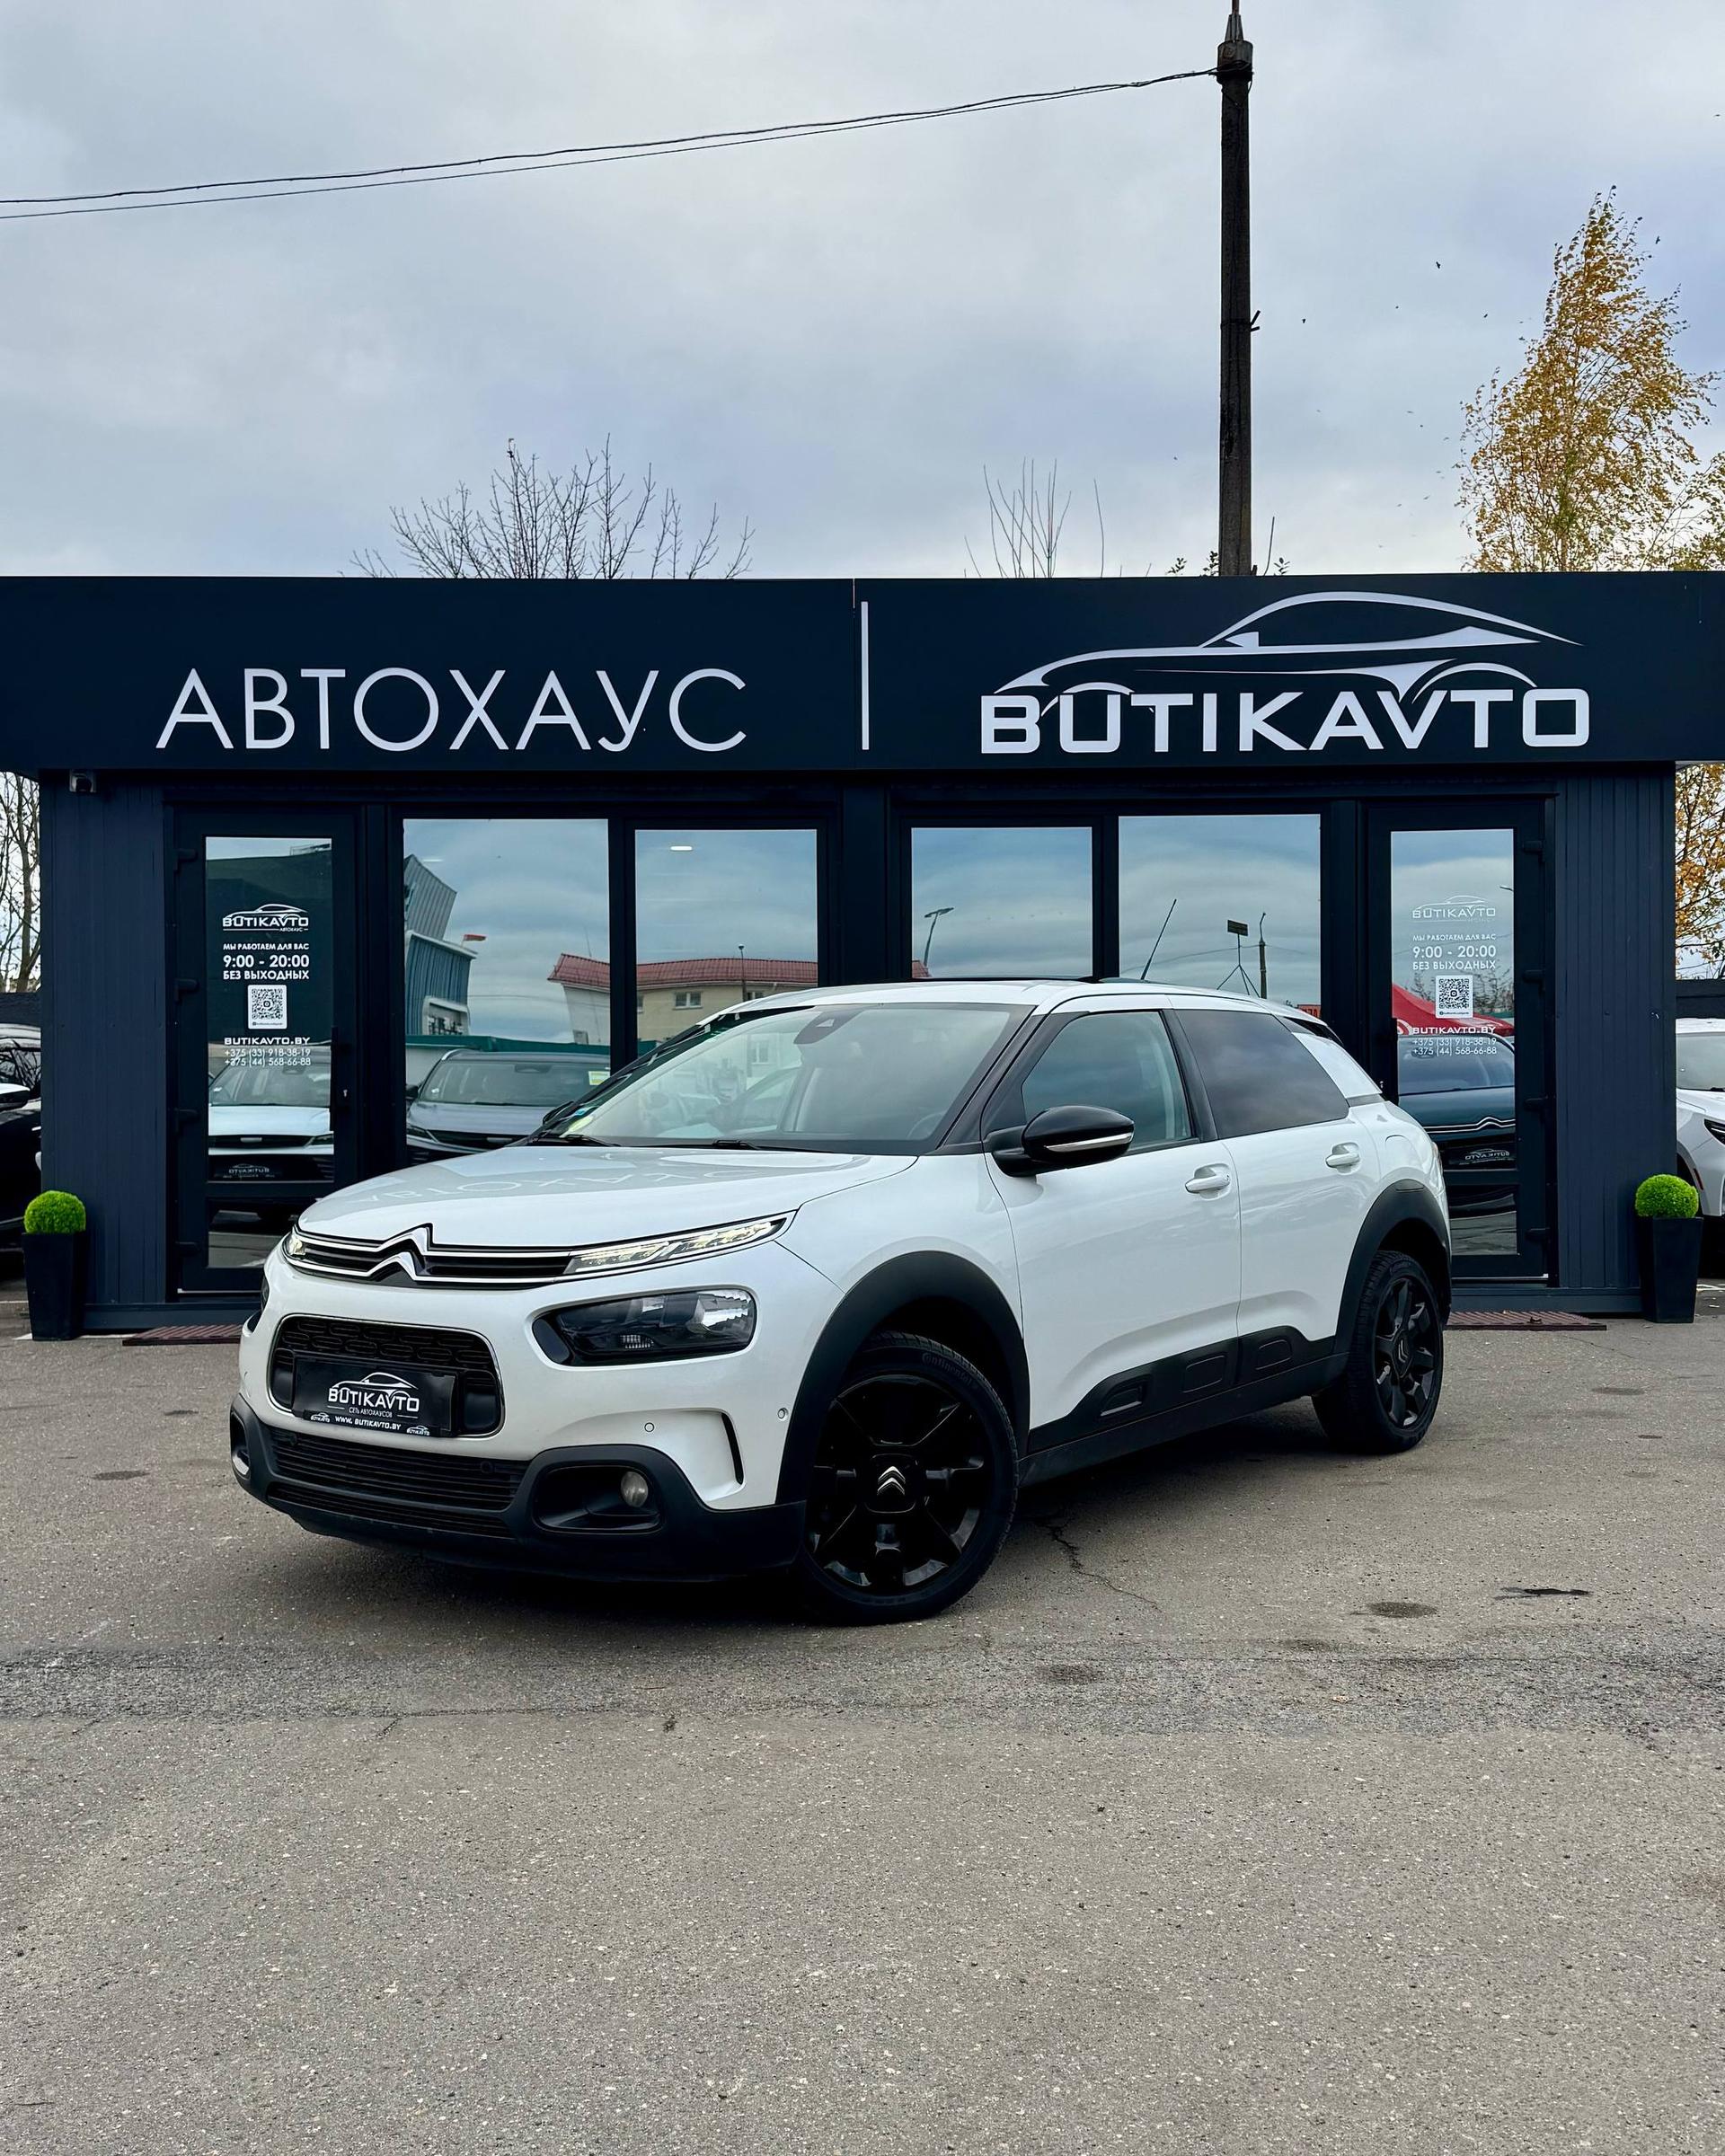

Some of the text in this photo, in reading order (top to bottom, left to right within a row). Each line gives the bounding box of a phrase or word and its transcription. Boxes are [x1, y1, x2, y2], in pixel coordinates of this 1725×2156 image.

[155, 667, 748, 753] АВТОХАУС
[981, 687, 1590, 754] BUTIKAVTO
[1412, 907, 1496, 919] BUTIKAVTO
[222, 917, 309, 927] BUTIKAVTO
[1412, 946, 1443, 959] 9:00
[1458, 945, 1497, 958] 20:00
[223, 955, 254, 968] 9:00
[270, 955, 310, 968] 20:00
[1412, 961, 1496, 970] БЕЗ ВЫХОДНЫХ
[223, 971, 310, 980] БЕЗ ВЫХОДНЫХ
[1412, 1026, 1497, 1034] BUTIKAVTO.BY
[224, 1037, 311, 1045] BUTIKAVTO.BY
[224, 1048, 311, 1058] +375 (33) 918-38-19
[1412, 1047, 1497, 1056] +375 (44) 568-66-88
[249, 1058, 266, 1067] (44)
[268, 1058, 311, 1066] 568-66-88
[328, 1387, 420, 1412] BUTIKAVTO
[334, 1416, 402, 1431] WWW. BUTIKAVTO.BY
